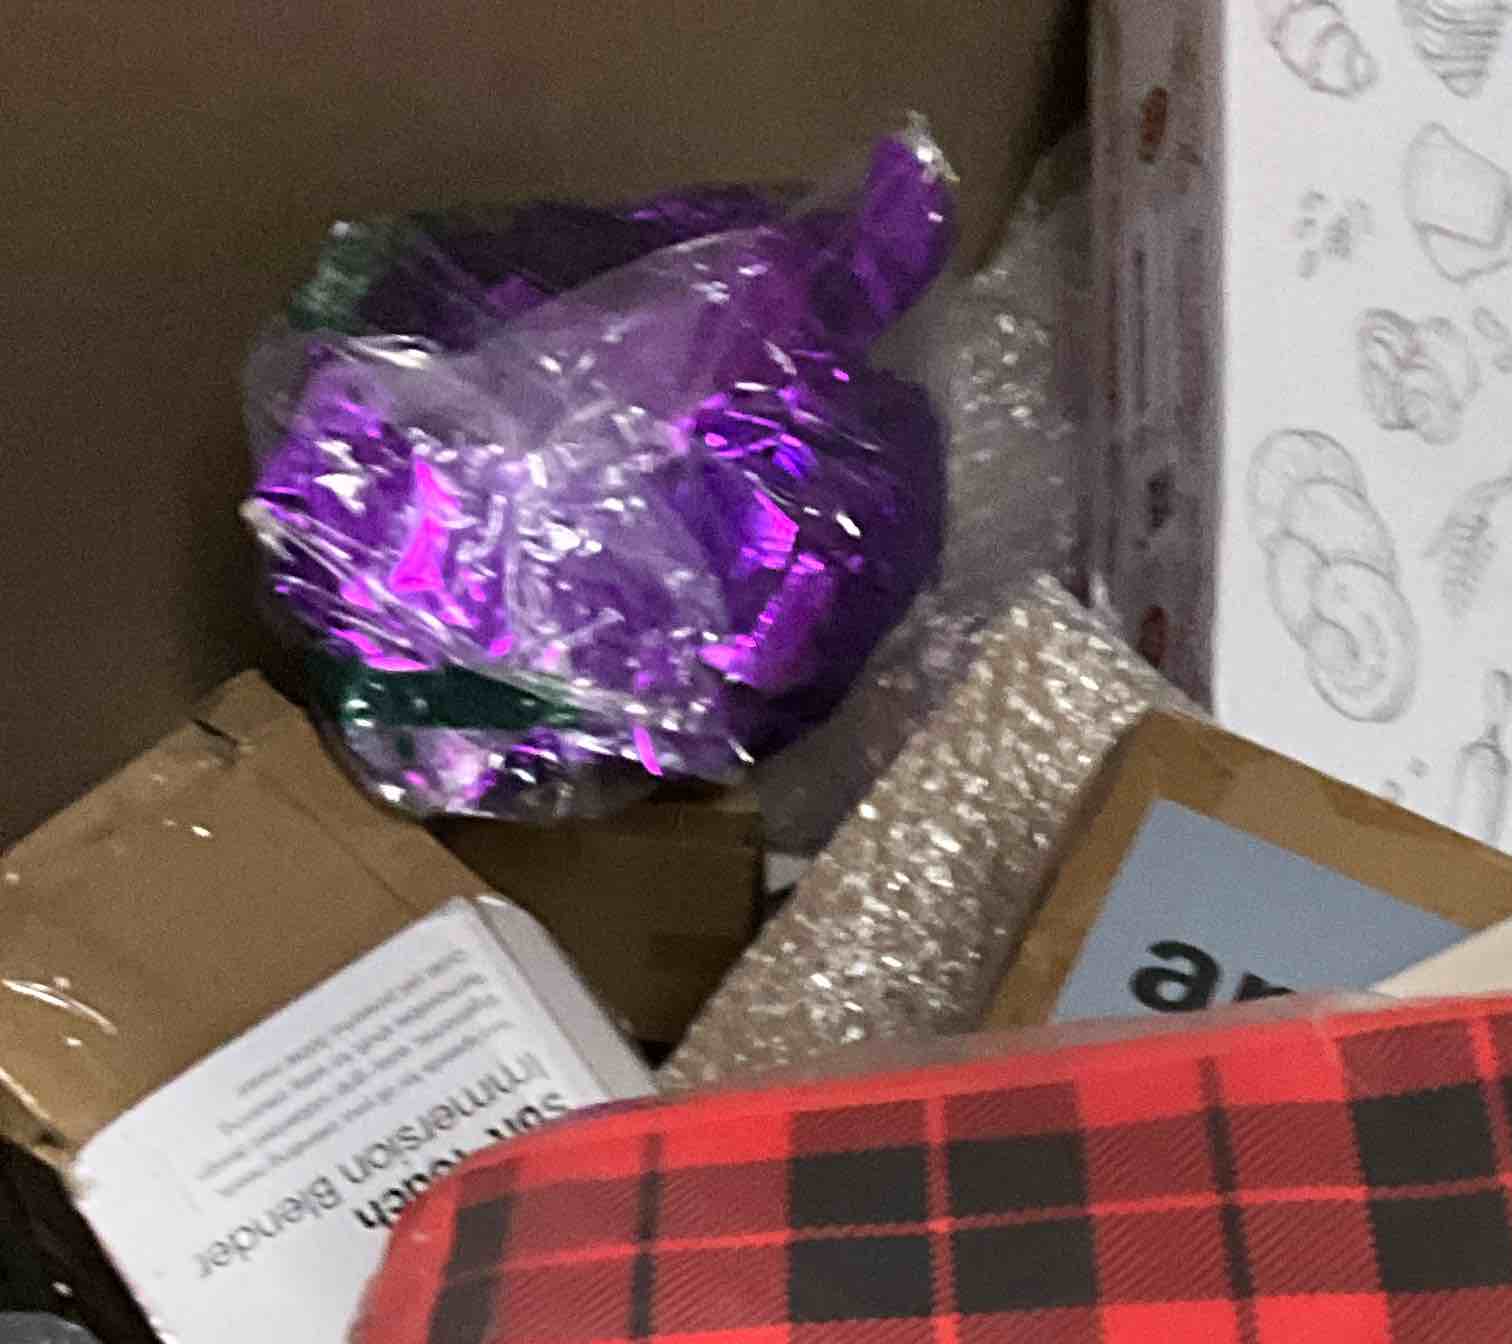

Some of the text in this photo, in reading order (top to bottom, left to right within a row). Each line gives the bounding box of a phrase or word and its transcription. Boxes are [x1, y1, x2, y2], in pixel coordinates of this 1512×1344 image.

[338, 1050, 549, 1184] Immersion
[192, 1175, 338, 1279] Blender
[353, 1147, 470, 1231] ouch
